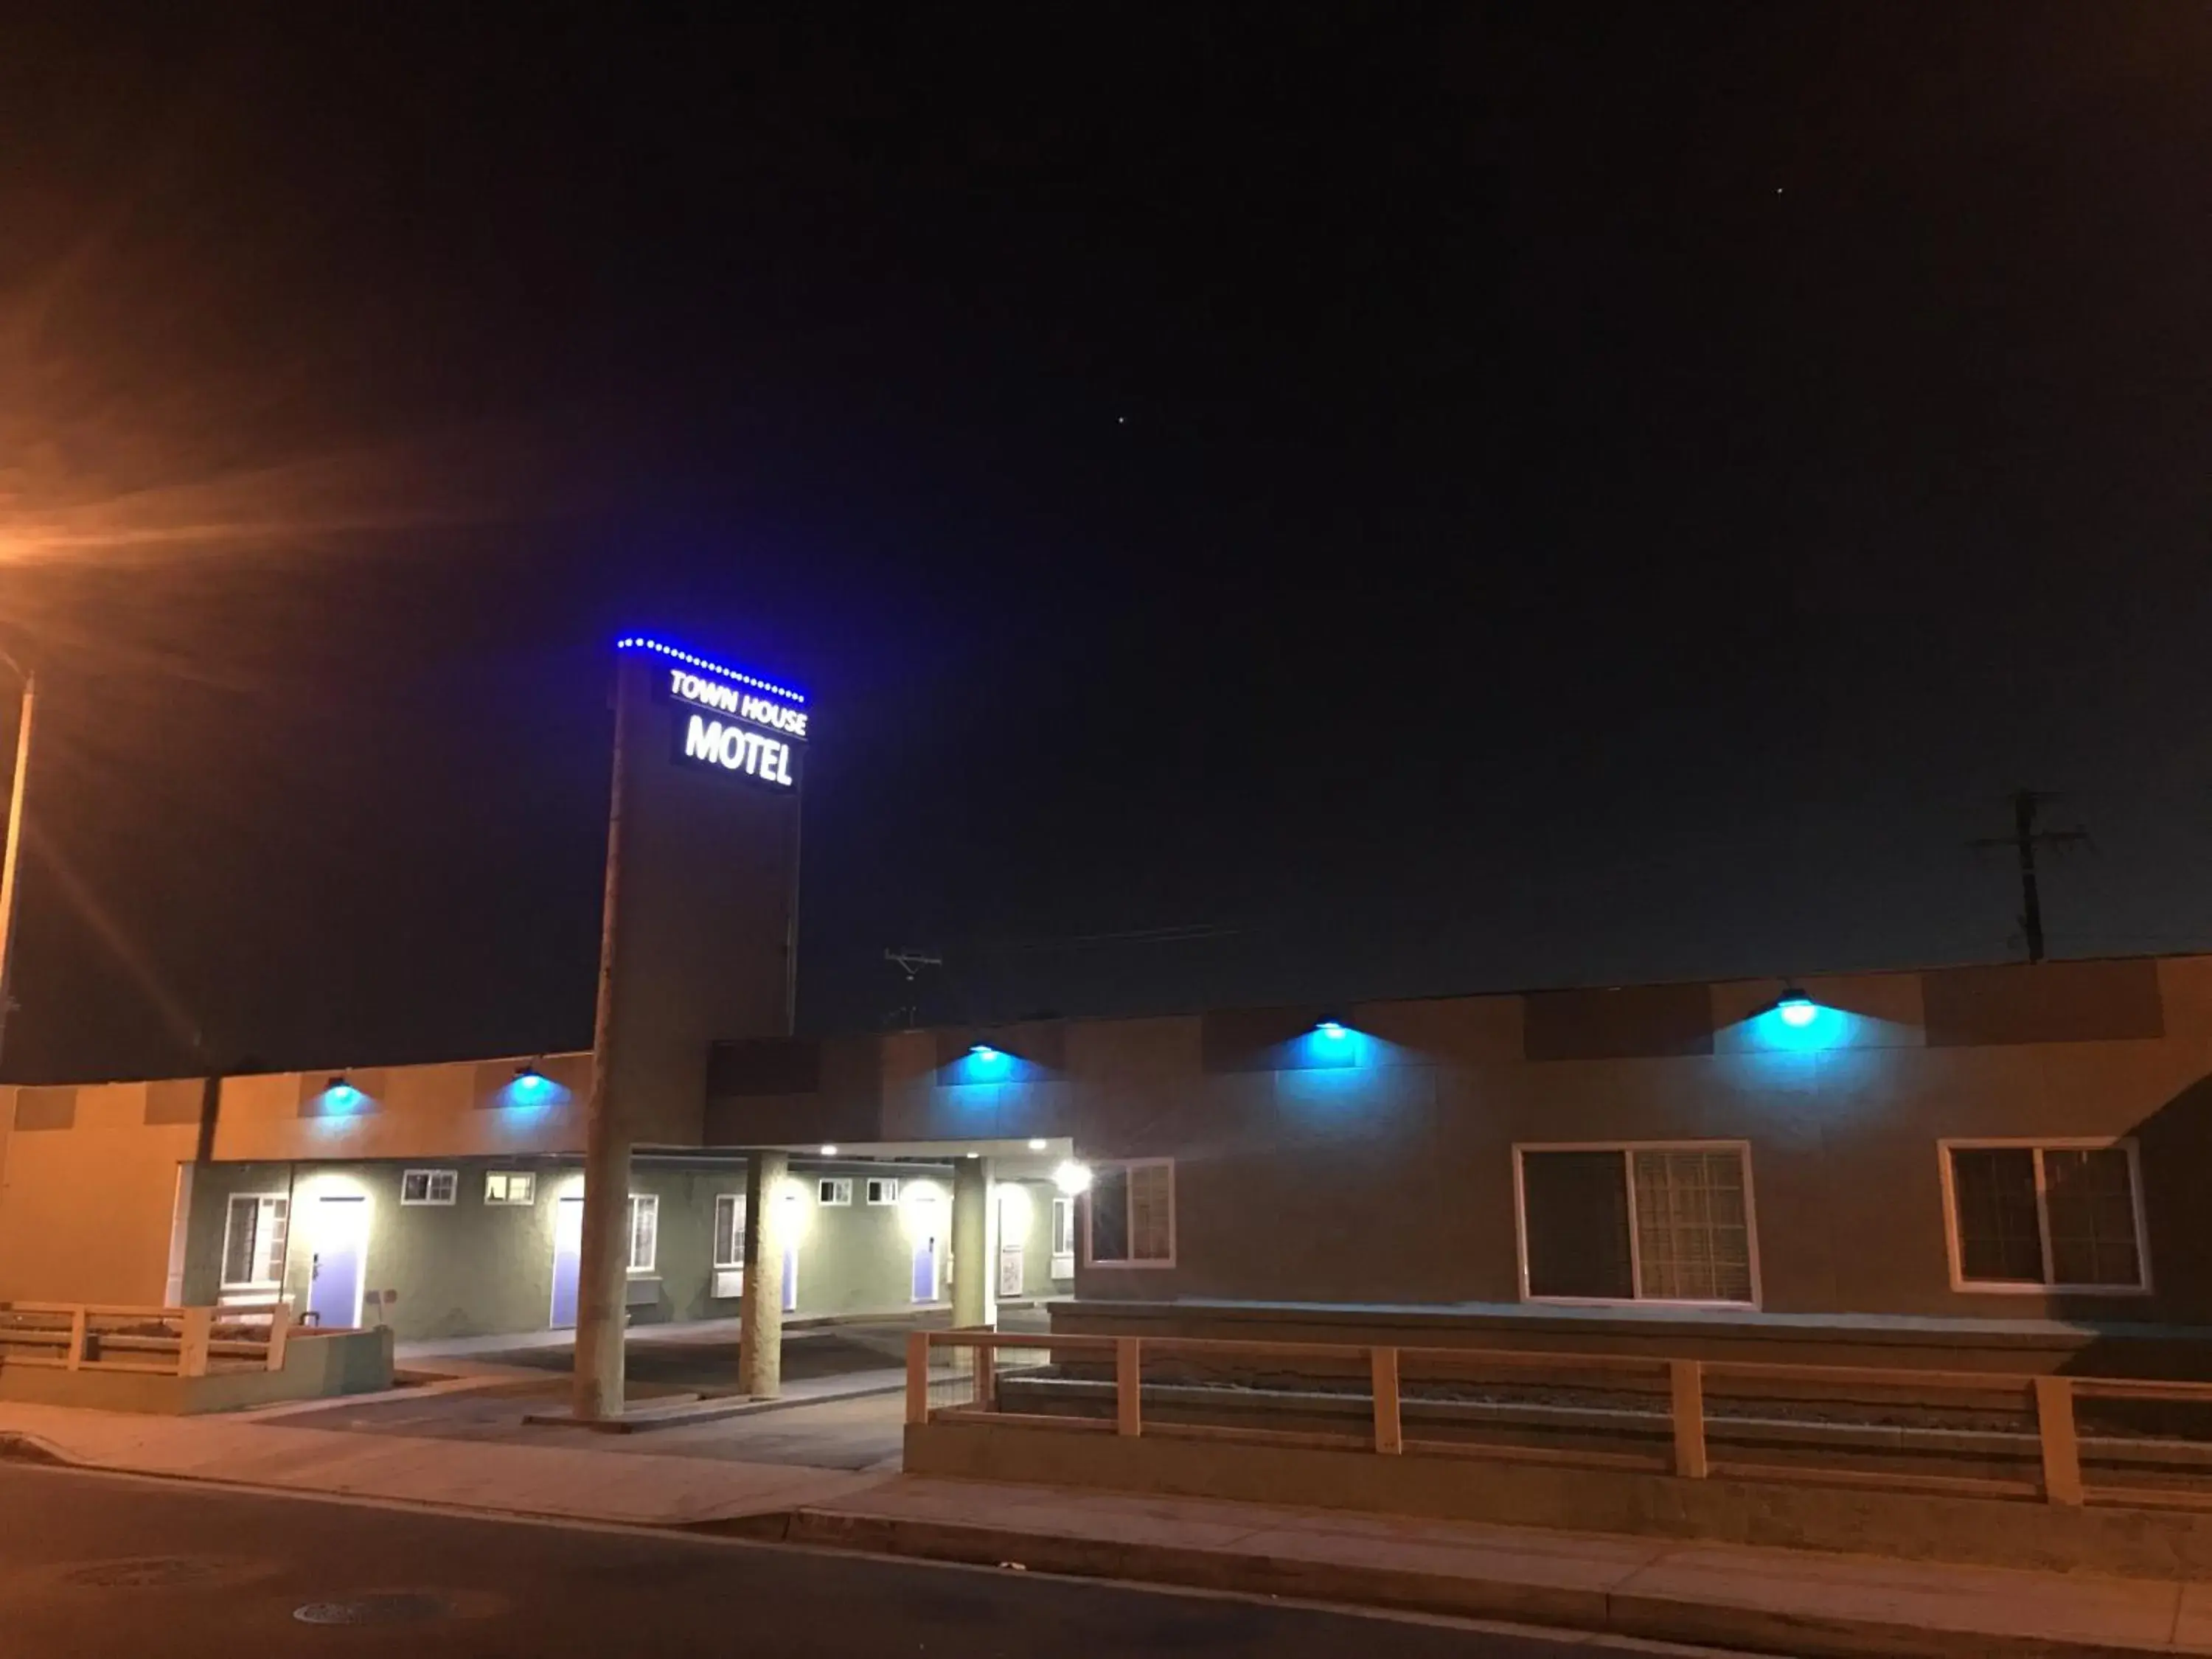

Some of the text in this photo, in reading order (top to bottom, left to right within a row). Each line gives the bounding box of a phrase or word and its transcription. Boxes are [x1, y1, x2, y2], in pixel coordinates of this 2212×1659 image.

[670, 669, 808, 737] TOWN HOUSE
[685, 714, 792, 786] MOTEL
